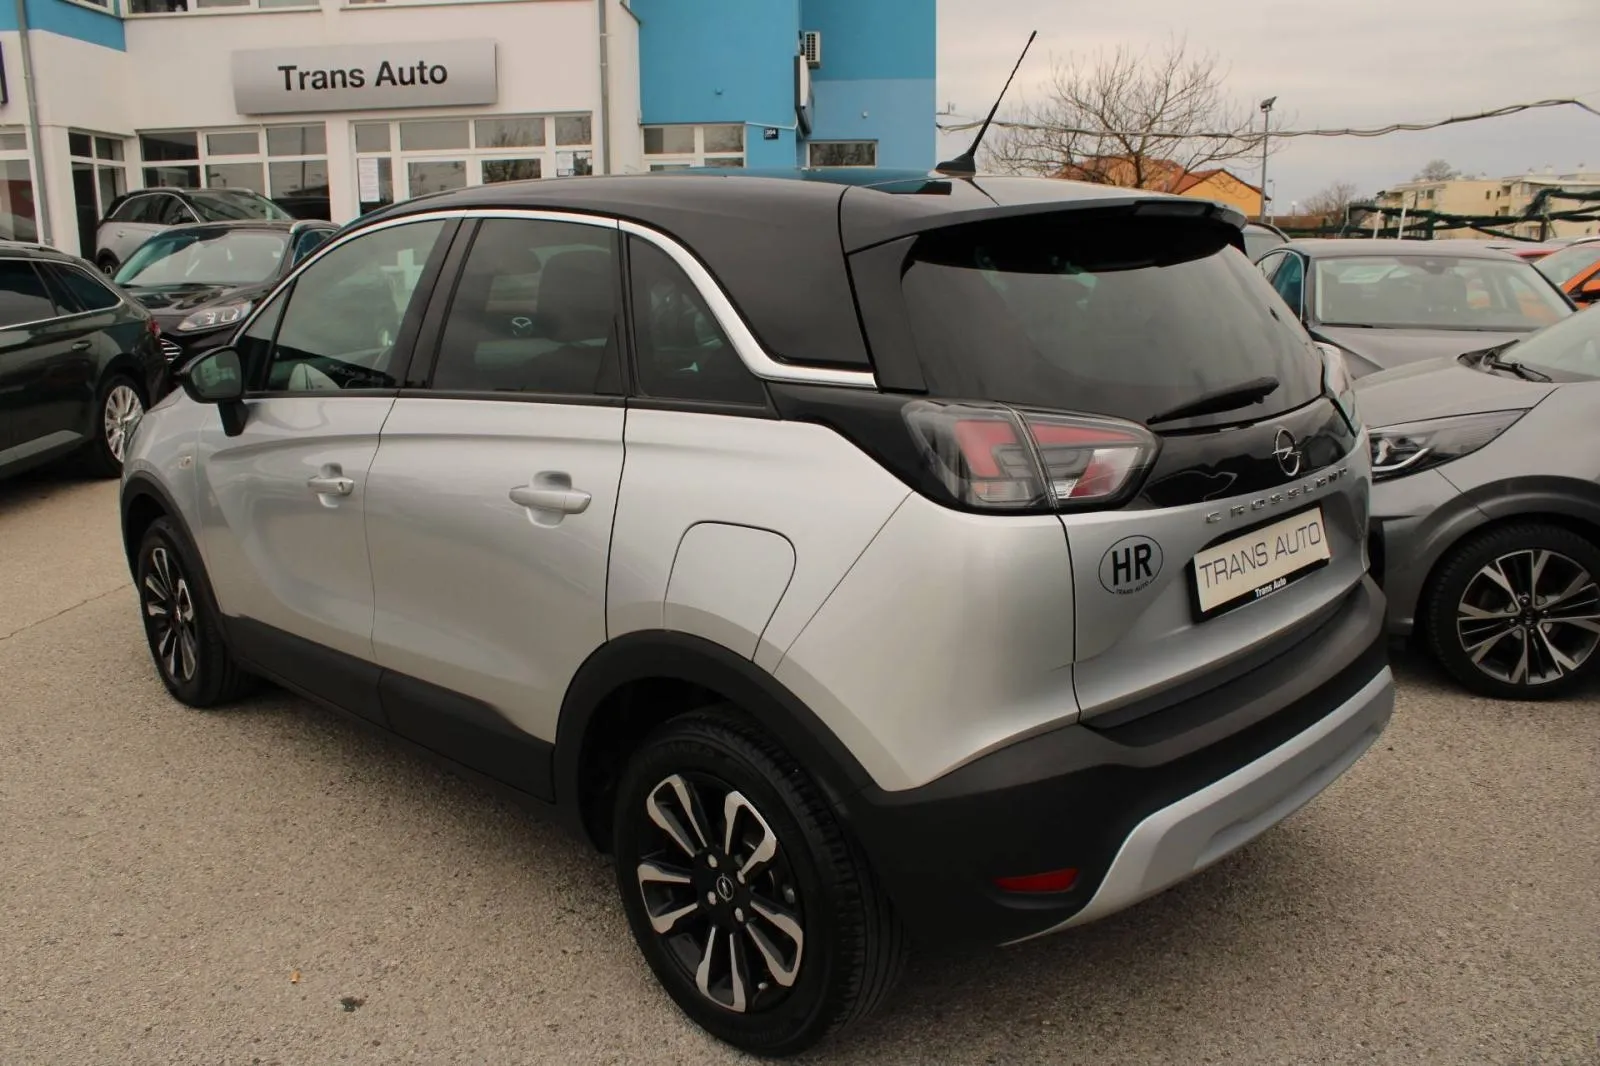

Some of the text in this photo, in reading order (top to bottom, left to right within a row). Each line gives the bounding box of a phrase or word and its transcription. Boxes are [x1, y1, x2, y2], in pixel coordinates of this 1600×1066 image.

[277, 60, 448, 91] Trans Auto
[1112, 543, 1153, 586] HR
[1199, 521, 1321, 589] TRANS AUTO
[1254, 577, 1287, 598] Trans Auto
